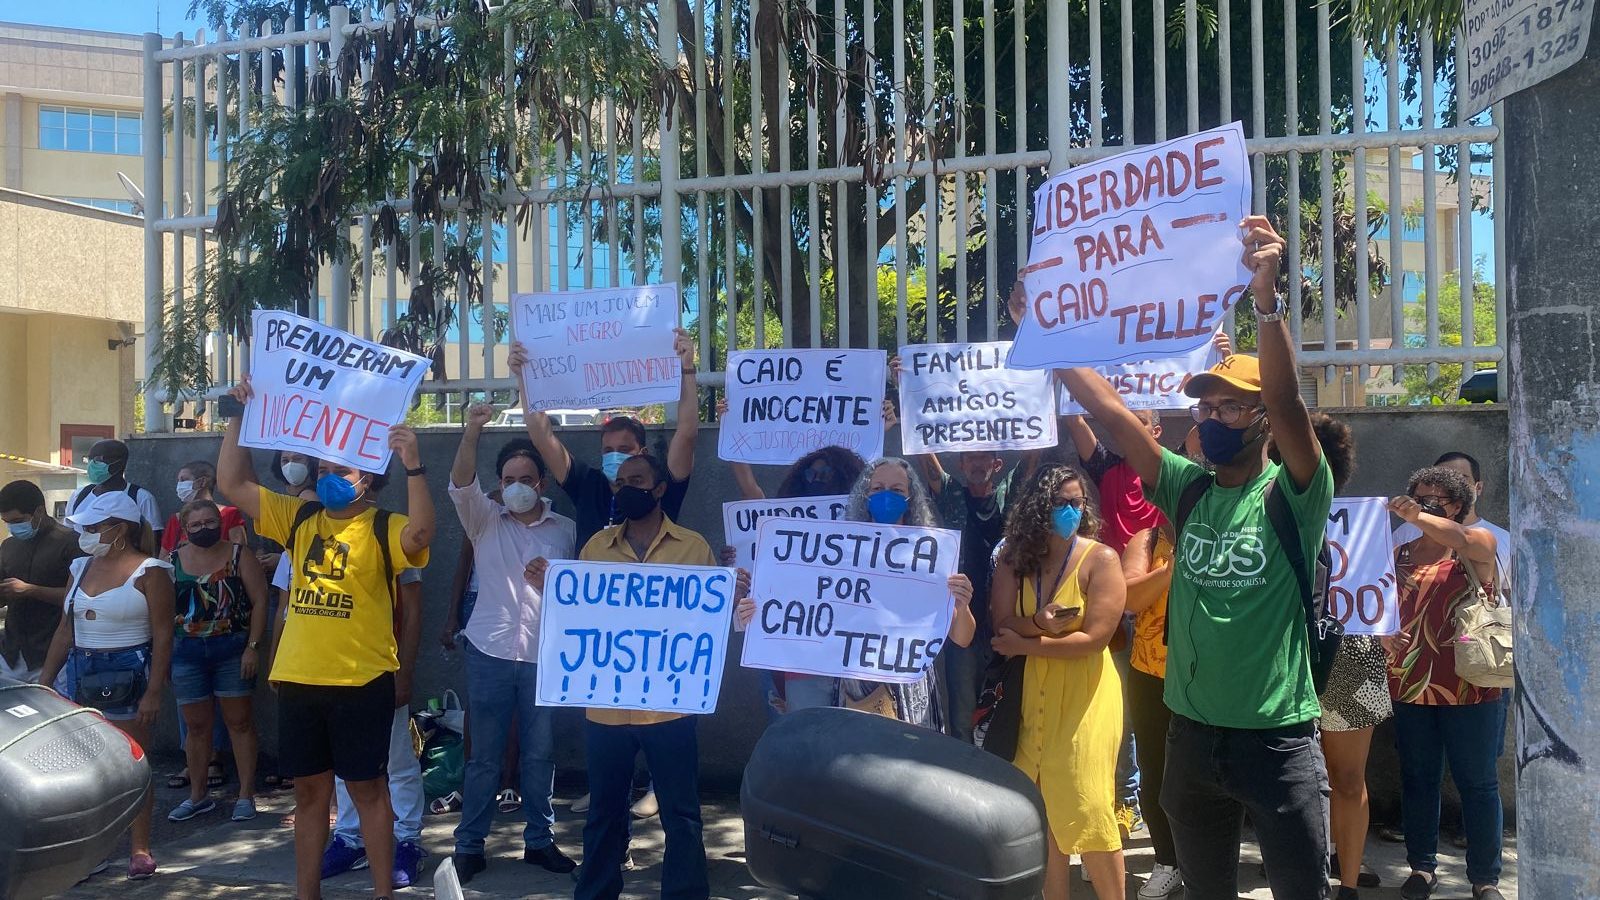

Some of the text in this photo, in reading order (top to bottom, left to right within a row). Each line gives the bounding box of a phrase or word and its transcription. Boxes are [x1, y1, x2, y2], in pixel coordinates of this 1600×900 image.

[1074, 215, 1165, 273] PARA
[525, 294, 660, 327] MAIS UM JOVEM
[1034, 278, 1109, 330] CAIO
[265, 319, 417, 379] PRENDERAM
[566, 321, 623, 346] NEGRO
[286, 358, 336, 391] UM
[528, 355, 682, 393] PRESO INJUSTAMENTE
[737, 354, 847, 385] CAIO É
[912, 345, 1000, 376] FAMÍLI
[922, 391, 1017, 414] AMIGOS
[958, 379, 969, 395] E
[743, 396, 872, 426] INOCENTE
[916, 416, 1043, 446] PRESENTES
[773, 530, 939, 574] JUSTIÇA
[555, 568, 727, 614] QUEREMOS
[817, 576, 872, 604] POR
[1231, 577, 1267, 588] SOCIALISTA
[761, 599, 834, 638] CAIO
[560, 628, 714, 682] JUSTIÇA
[835, 630, 943, 674] TELLES
